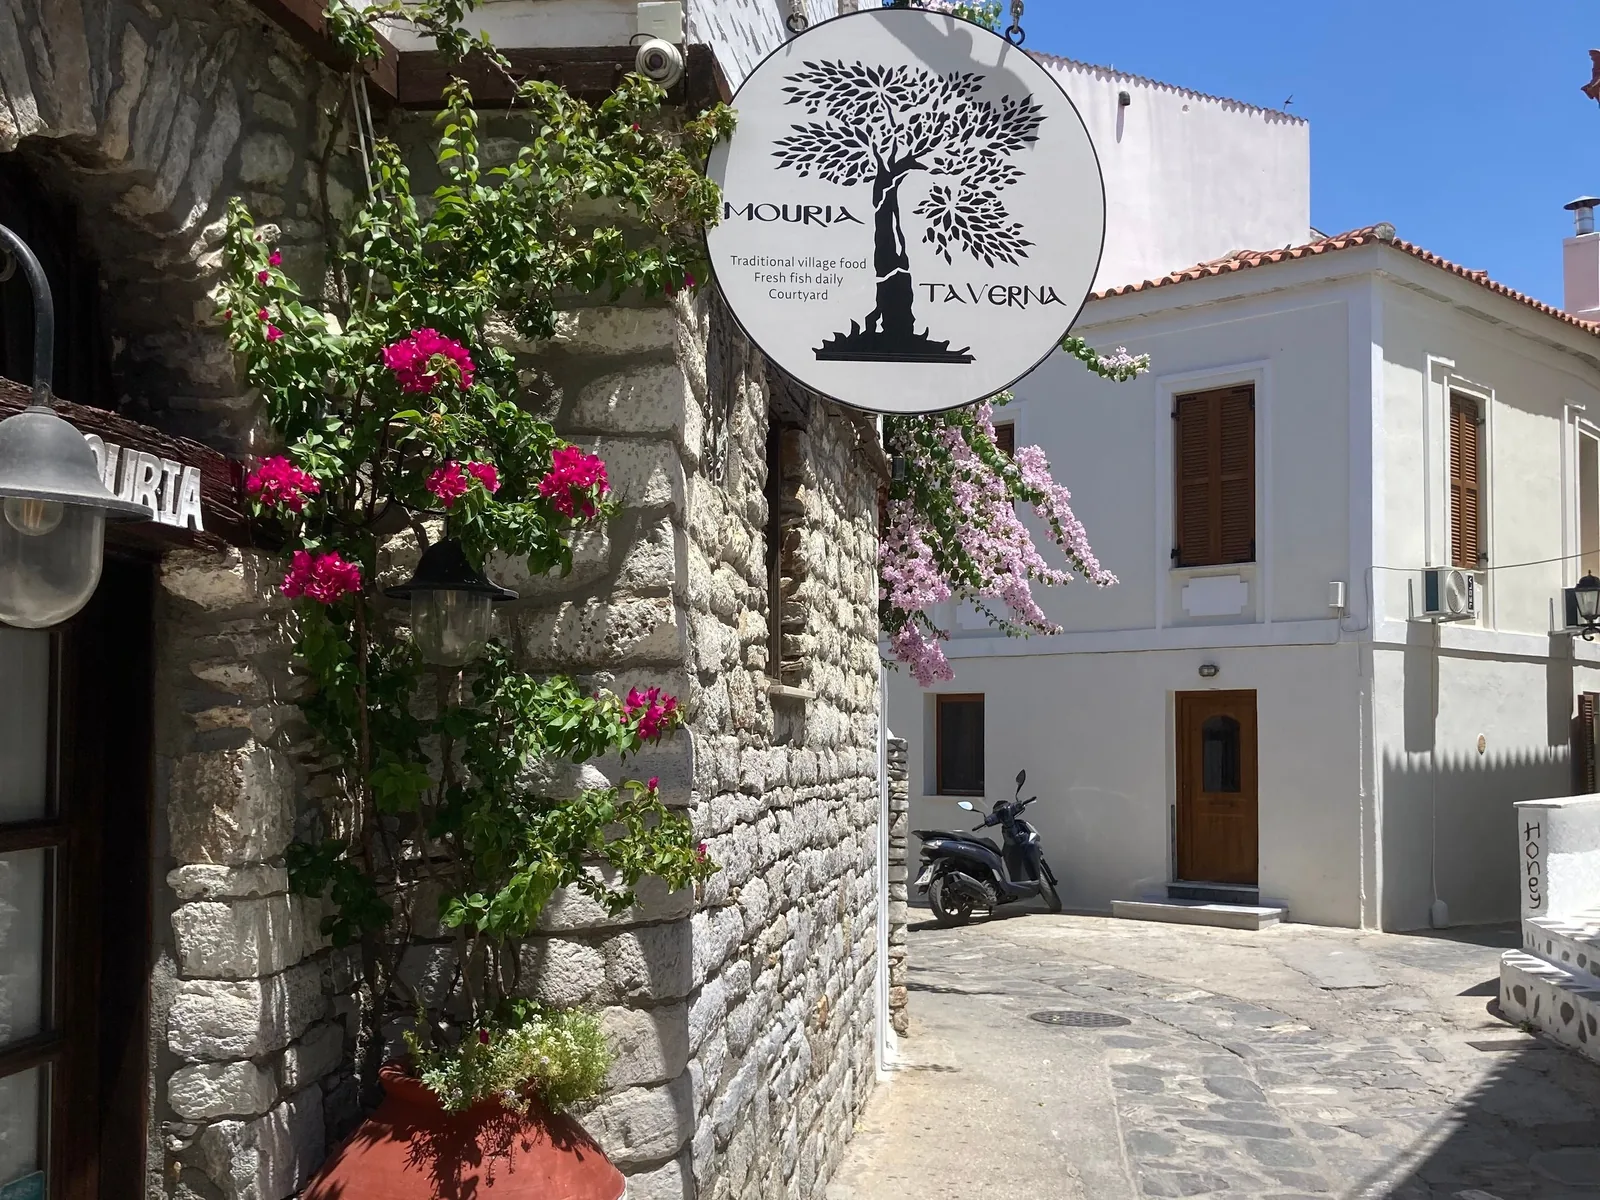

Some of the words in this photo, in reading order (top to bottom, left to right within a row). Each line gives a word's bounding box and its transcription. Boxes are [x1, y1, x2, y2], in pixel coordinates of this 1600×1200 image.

[724, 202, 866, 228] MOURIA
[730, 255, 795, 268] Traditional
[797, 257, 836, 271] village
[839, 257, 867, 269] food
[754, 272, 786, 283] Fresh
[789, 272, 812, 284] fish
[815, 273, 844, 287] daily
[768, 288, 829, 302] Courtyard
[918, 282, 1067, 310] TAVERNA
[1523, 822, 1541, 909] Honey
